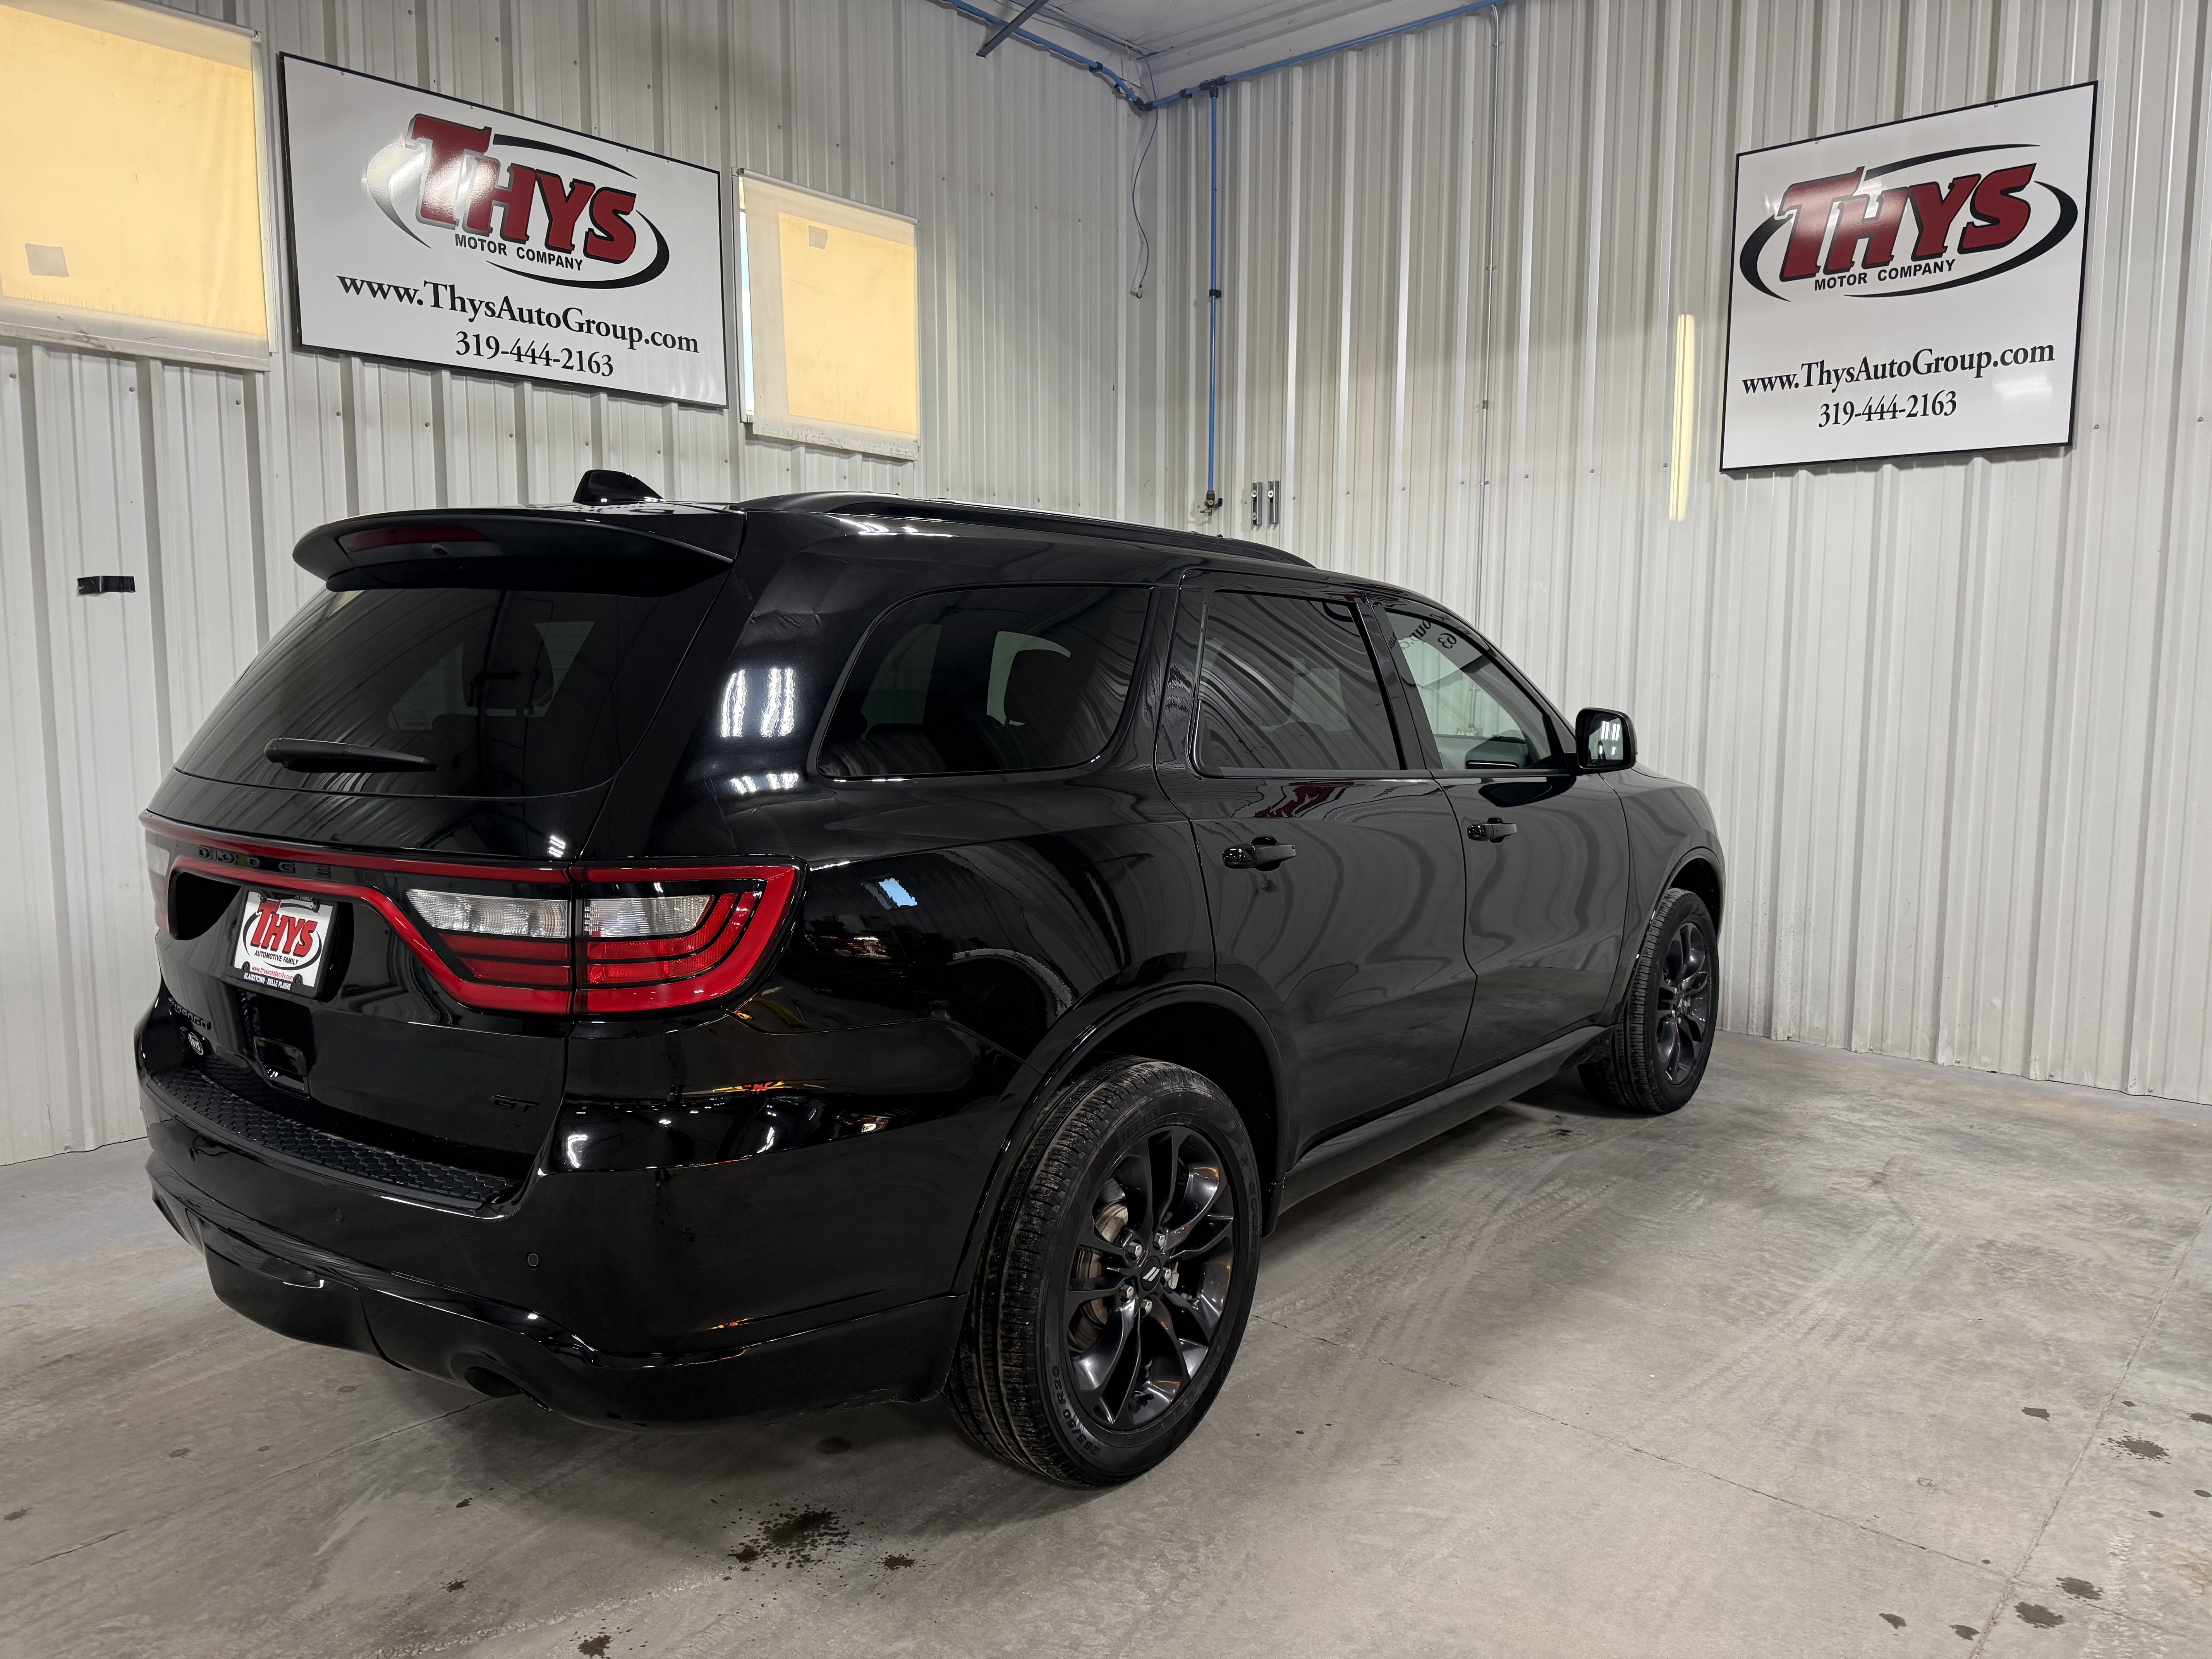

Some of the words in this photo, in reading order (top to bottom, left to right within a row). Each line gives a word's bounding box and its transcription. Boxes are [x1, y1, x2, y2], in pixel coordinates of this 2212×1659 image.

[407, 113, 637, 264] THYS
[1776, 163, 2037, 282] THYS
[455, 234, 507, 256] MOTOR
[516, 247, 583, 271] COMPANY
[1814, 272, 1867, 291] MOTOR
[1877, 259, 1956, 281] COMPANY
[336, 275, 700, 354] www.ThysAutoGroup.com
[456, 331, 614, 377] 319-444-2163
[1742, 344, 2055, 394] www.ThysAutoGroup.com
[1818, 390, 1957, 428] 319-444-2163
[199, 847, 331, 878] DODGE
[251, 900, 318, 958] THYS
[251, 966, 294, 981] www.thysautofamily.com
[254, 950, 282, 962] AUTOMOTIVE
[283, 957, 299, 965] FAMILY
[244, 972, 266, 984] BLAIRSTOWN
[267, 978, 278, 988] BELLE
[278, 981, 292, 990] PLAINE
[489, 1094, 540, 1112] GT
[1052, 1365, 1066, 1405] R20
[1063, 1409, 1100, 1455] 265/50
